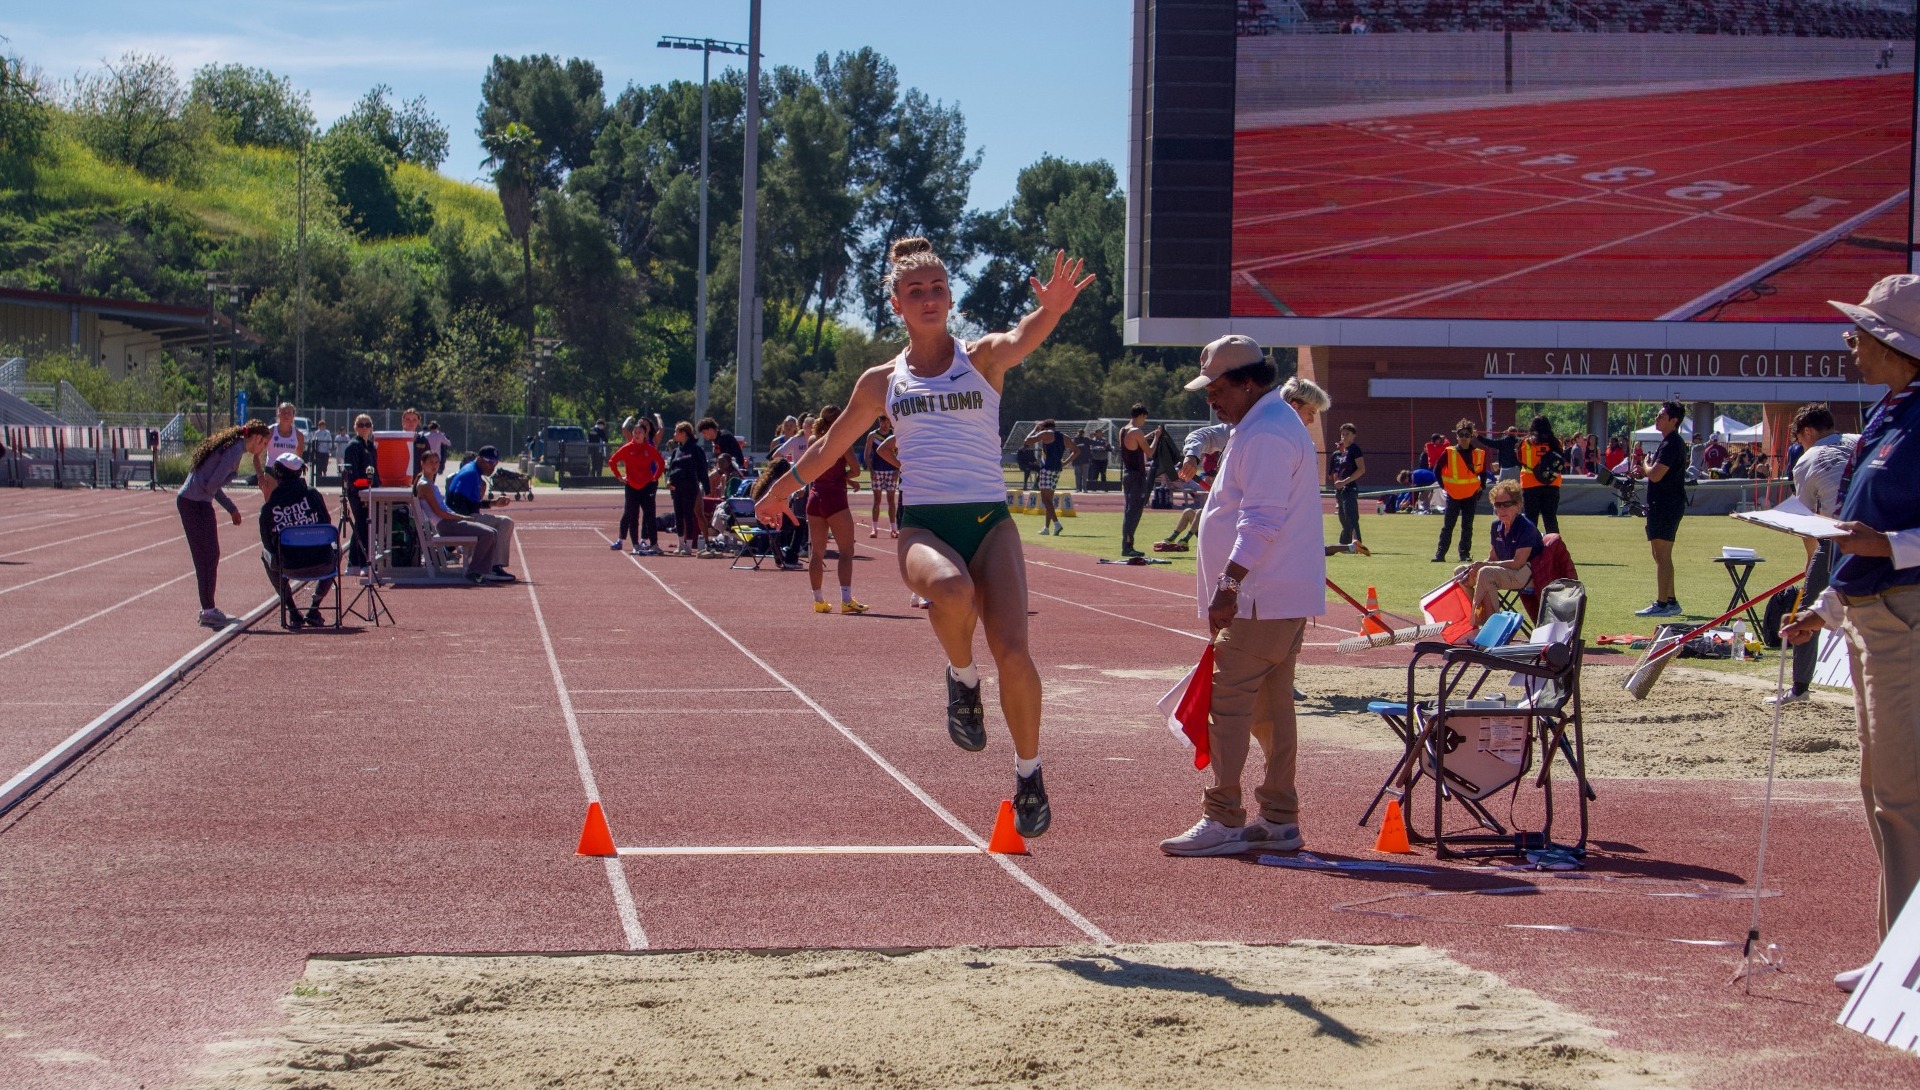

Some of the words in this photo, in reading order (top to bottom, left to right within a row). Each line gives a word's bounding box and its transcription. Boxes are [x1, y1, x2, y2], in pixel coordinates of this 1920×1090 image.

[1581, 166, 1656, 182] 3
[1665, 179, 1752, 200] 2
[1484, 352, 1525, 375] MT.
[1545, 352, 1590, 375] SAN
[1609, 353, 1720, 376] ANTONIO
[1739, 354, 1846, 377] COLLEGE
[891, 394, 935, 421] POINT
[938, 390, 984, 412] LOMA
[272, 497, 311, 523] Send
